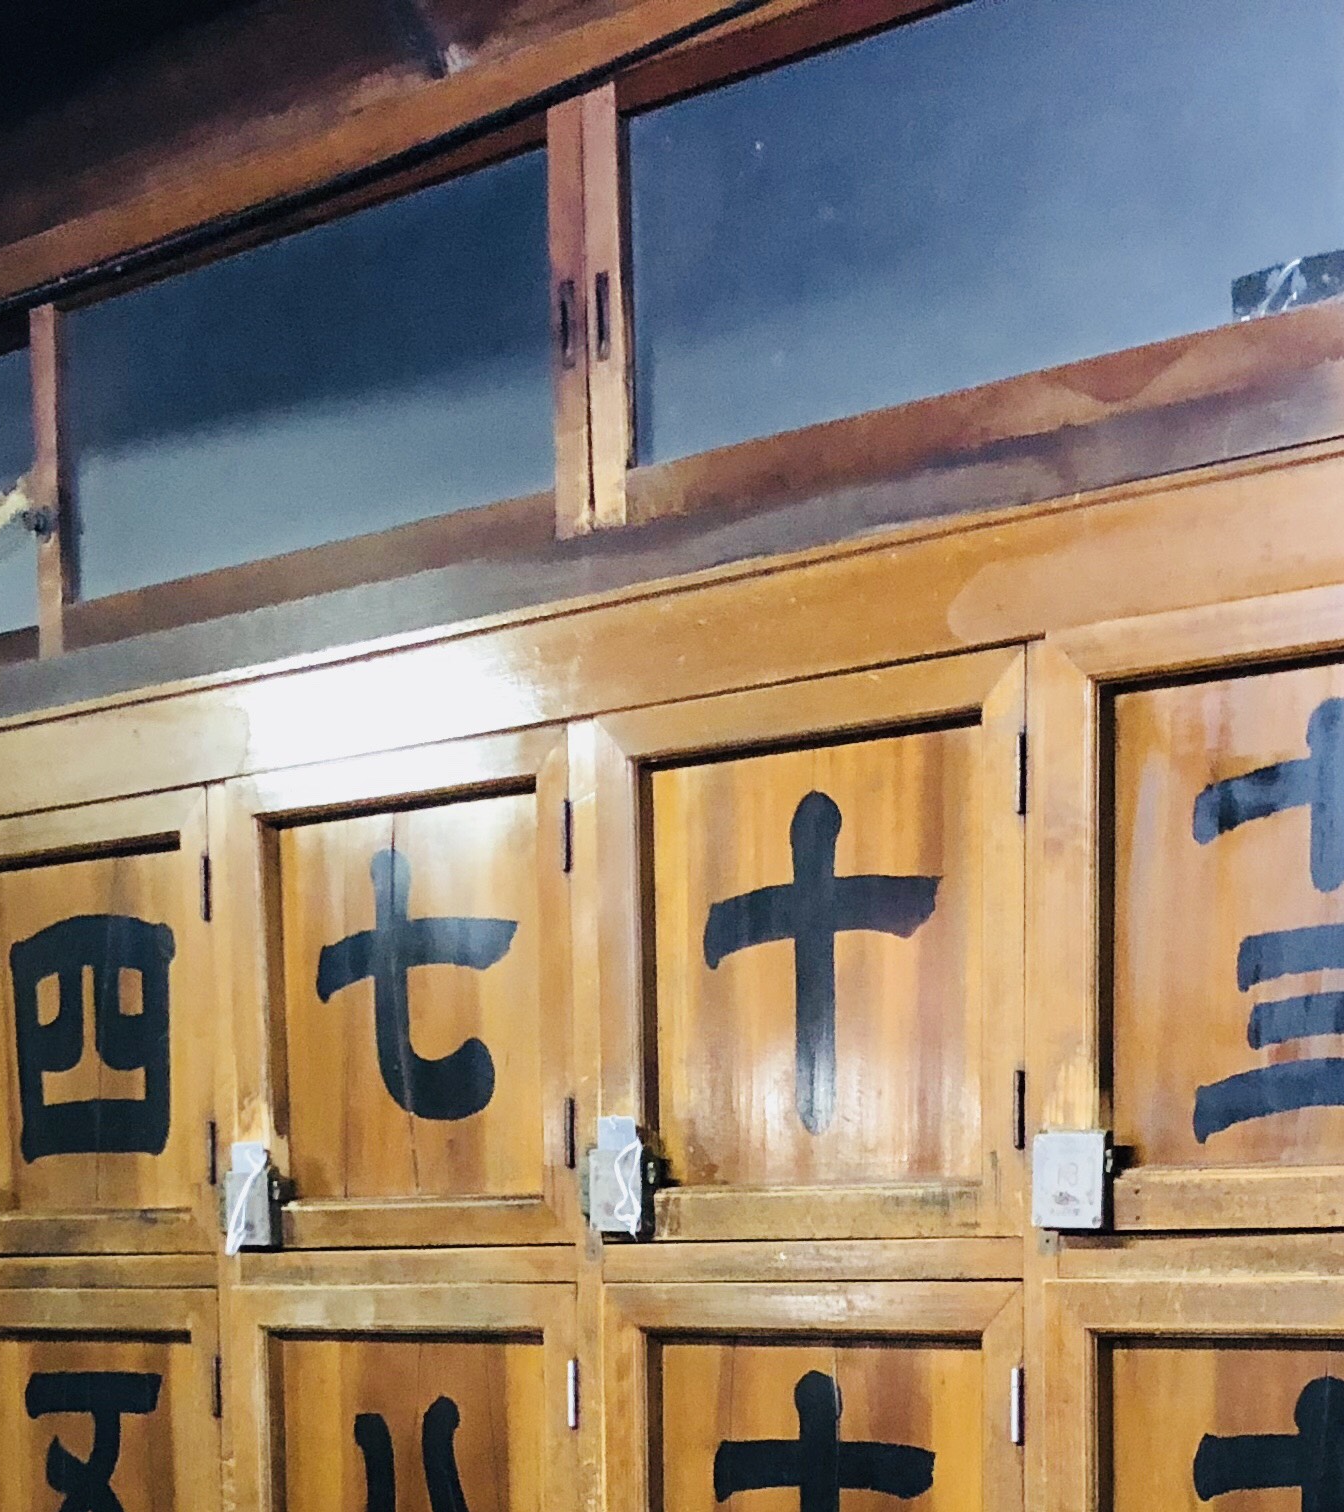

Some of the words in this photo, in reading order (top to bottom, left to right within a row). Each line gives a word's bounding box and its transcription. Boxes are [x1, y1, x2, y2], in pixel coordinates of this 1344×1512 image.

[9, 914, 176, 1164] 四
[317, 848, 519, 1120] 七
[703, 789, 943, 1135] 十
